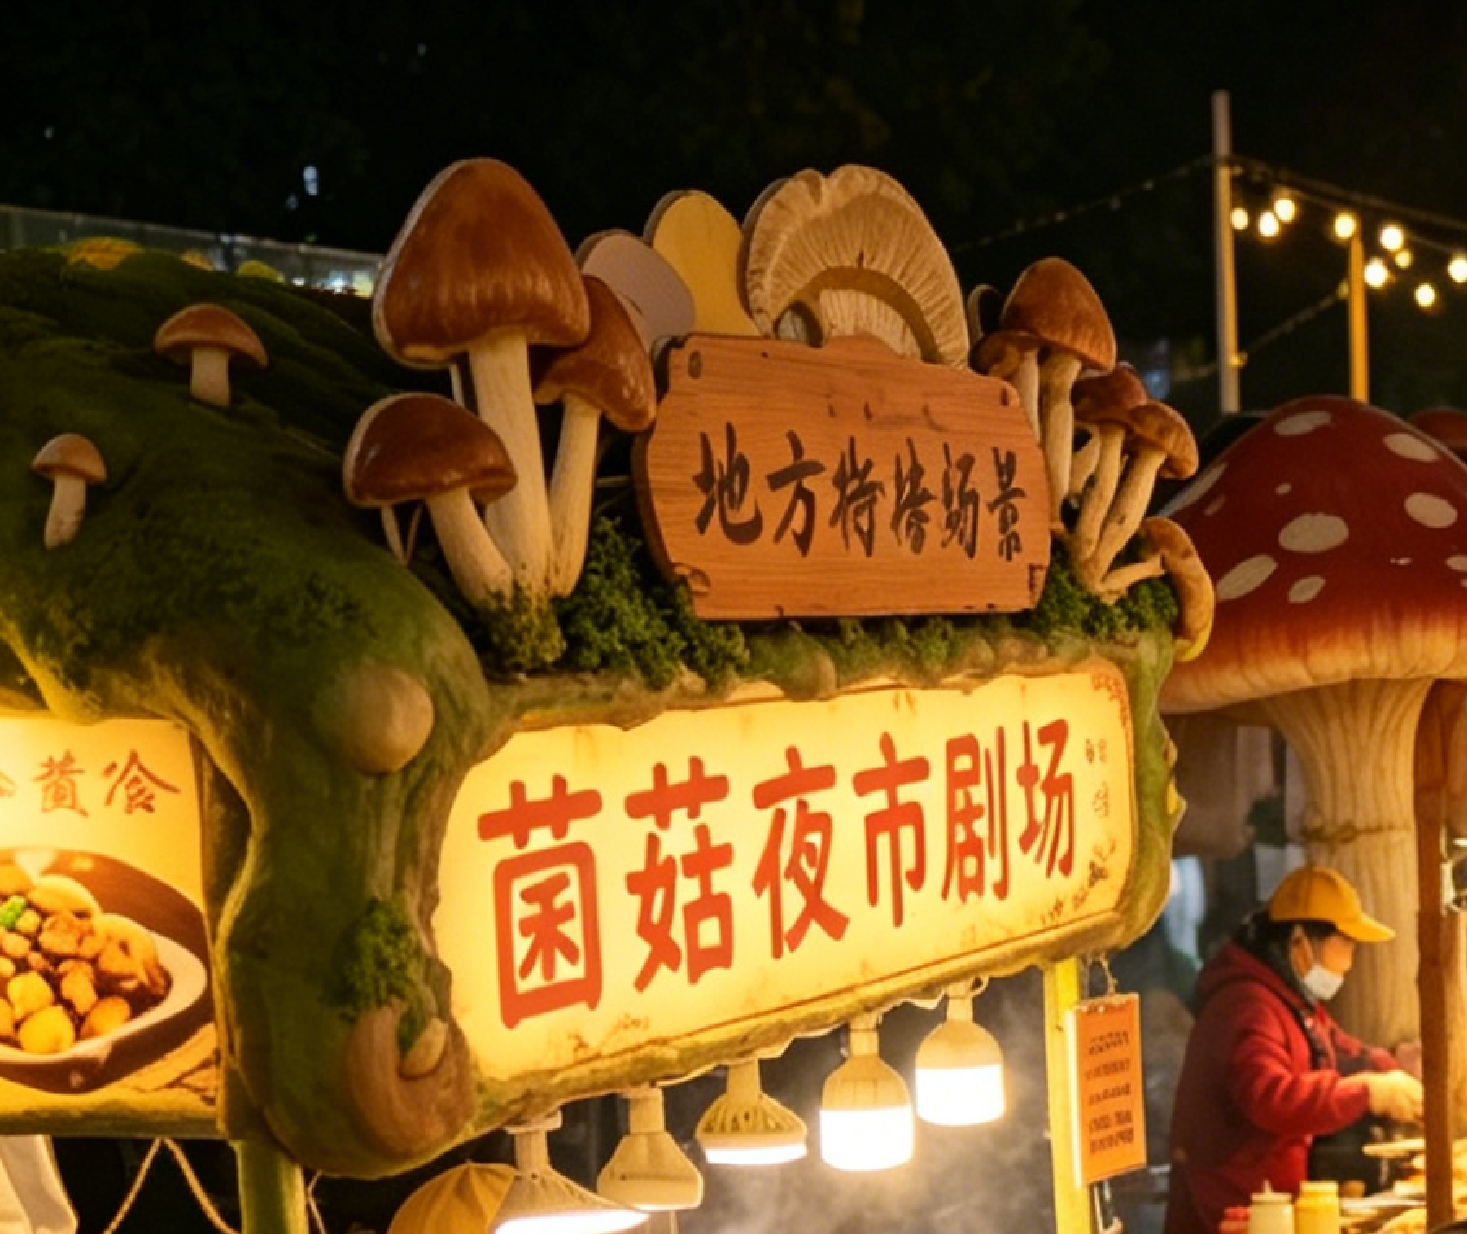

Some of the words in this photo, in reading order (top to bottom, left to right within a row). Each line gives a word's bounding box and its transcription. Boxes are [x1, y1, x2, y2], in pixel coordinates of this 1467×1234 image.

[477, 717, 1077, 1031] 菌菇夜市剧场
